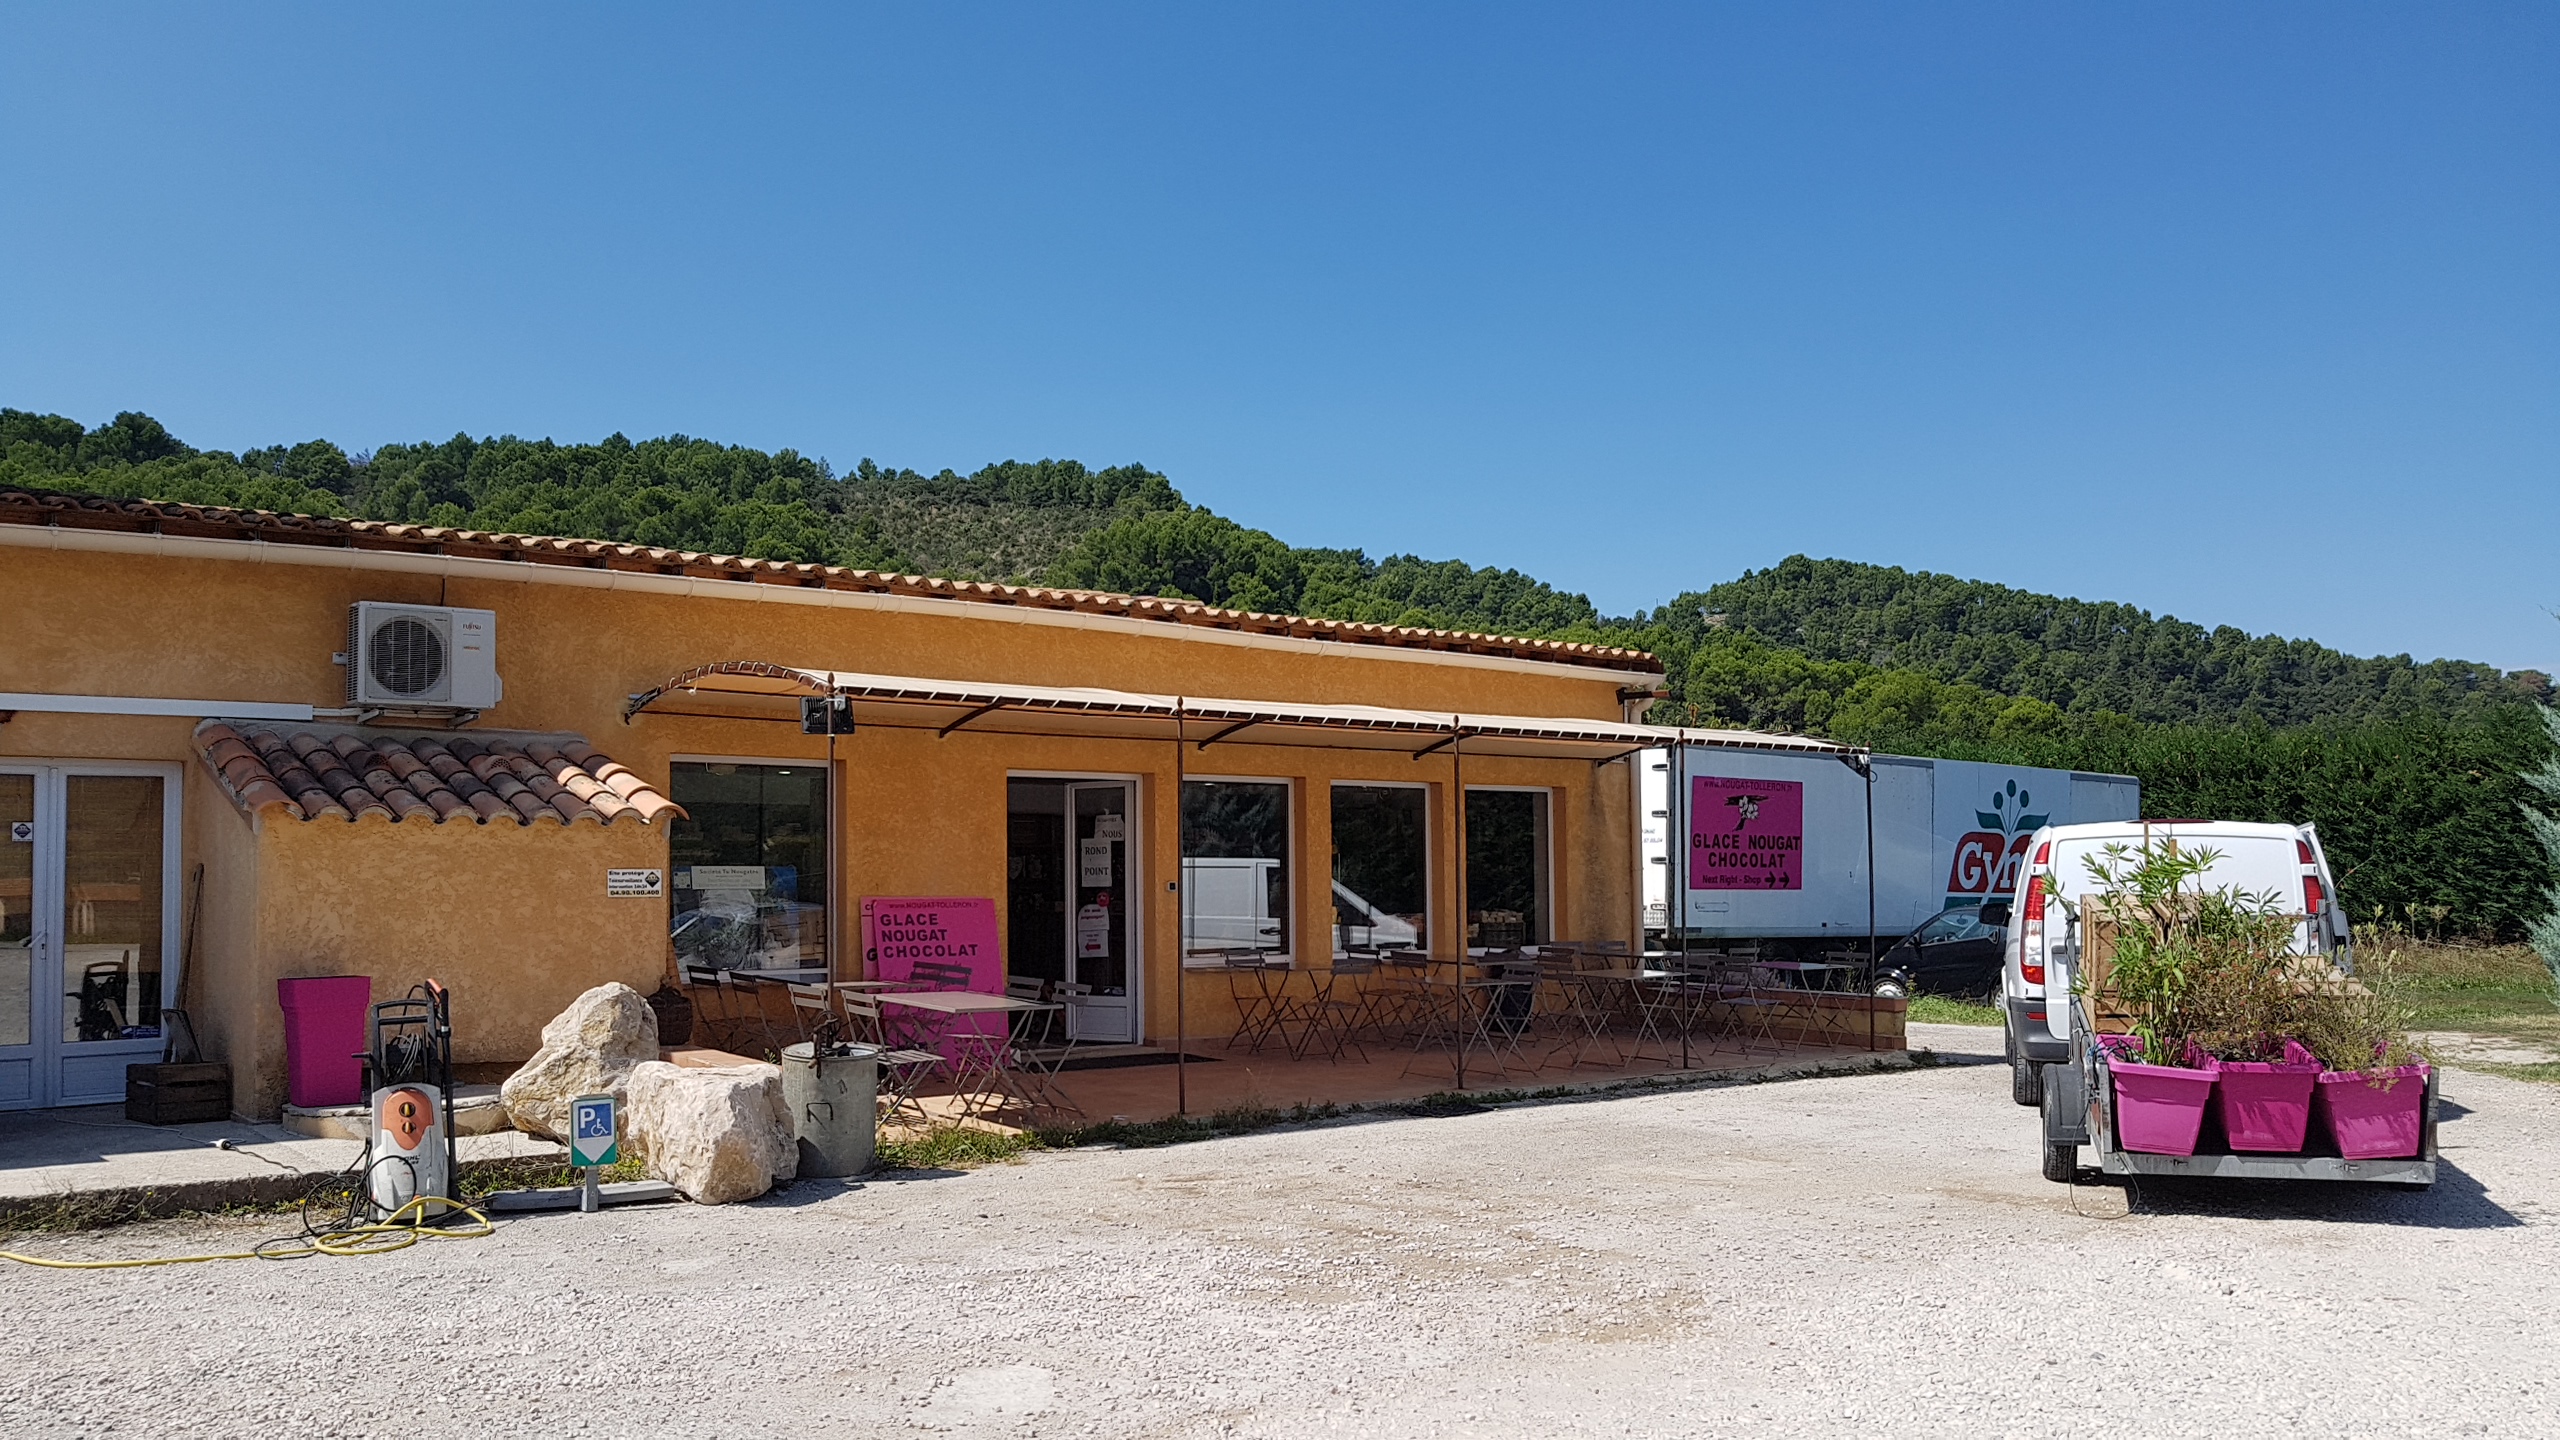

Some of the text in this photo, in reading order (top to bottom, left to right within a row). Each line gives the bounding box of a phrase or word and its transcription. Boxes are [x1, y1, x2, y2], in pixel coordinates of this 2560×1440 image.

[1102, 830, 1122, 838] NOUS
[1693, 834, 1801, 851] GLACE NOUGAT
[1085, 847, 1107, 855] ROND
[1708, 852, 1786, 868] CHOCOLAT
[1084, 867, 1109, 875] POINT
[1702, 875, 1718, 884] Next
[1720, 875, 1738, 886] Right
[880, 914, 939, 926] GLACE
[881, 930, 948, 942] NOUGAT
[883, 944, 978, 958] CHOCOLAT
[580, 1108, 596, 1129] P
